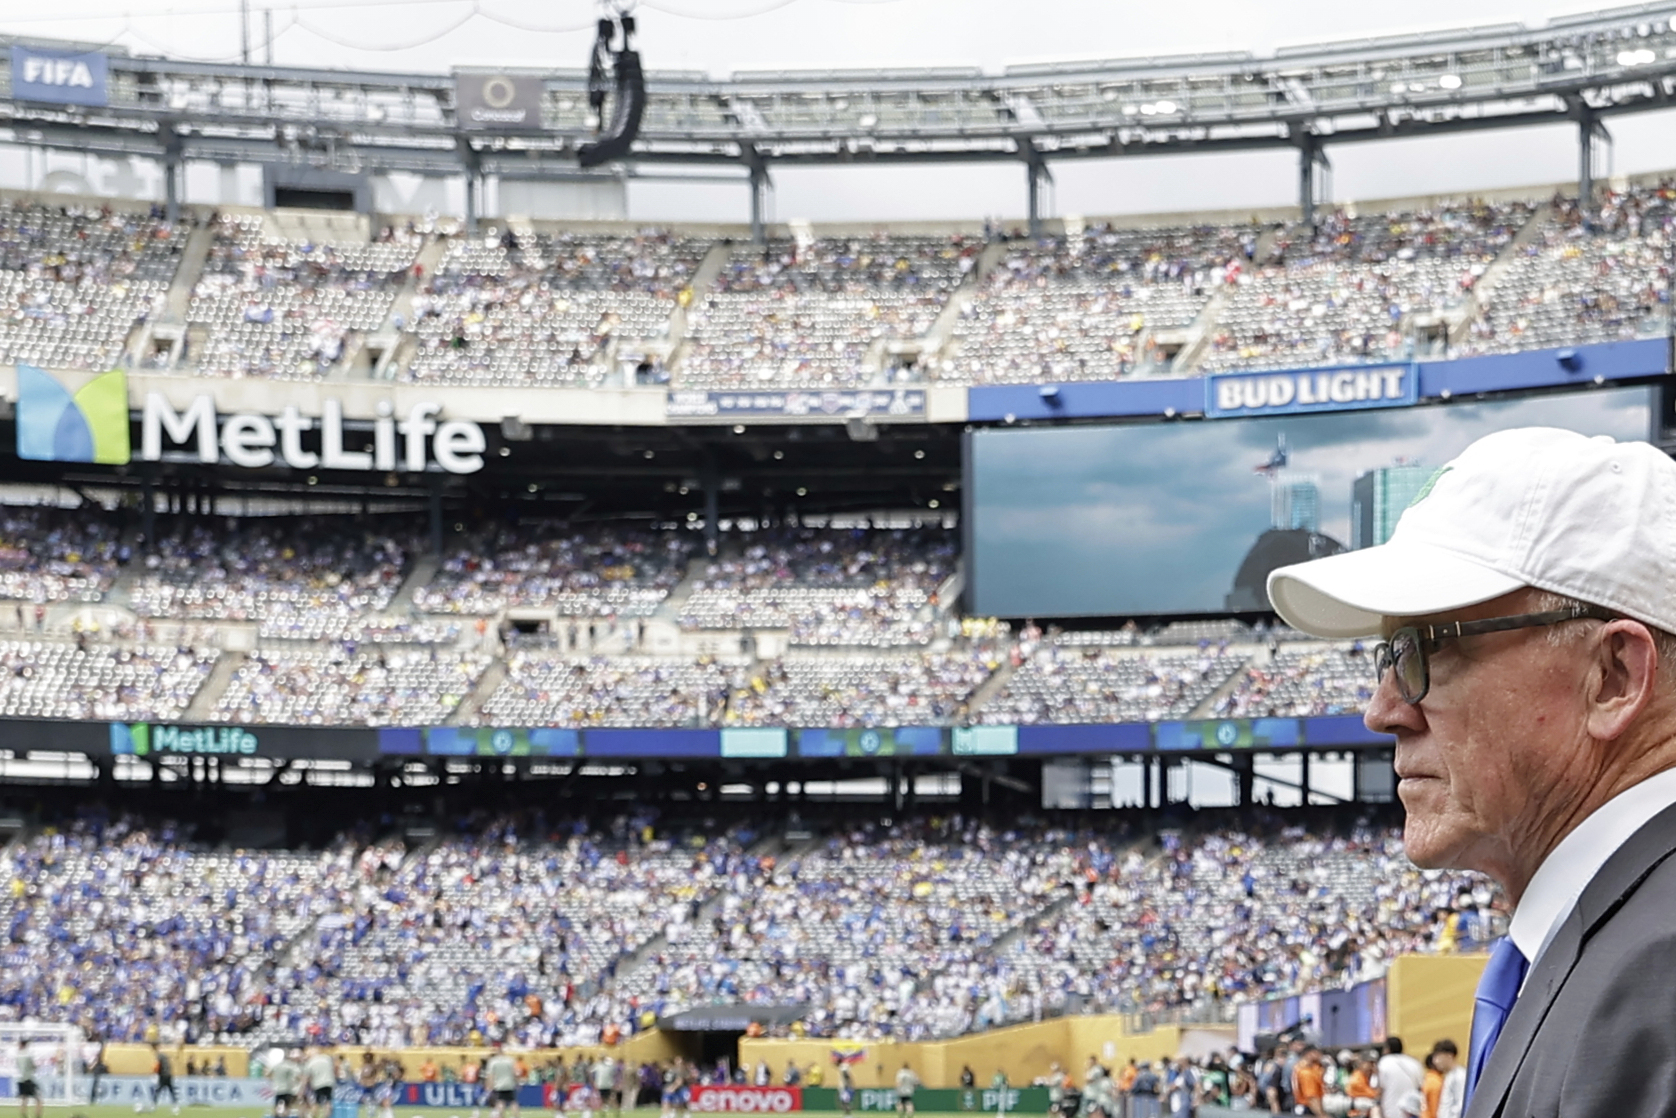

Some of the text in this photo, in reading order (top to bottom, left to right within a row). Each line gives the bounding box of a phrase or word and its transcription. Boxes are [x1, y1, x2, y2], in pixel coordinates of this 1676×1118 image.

[23, 56, 94, 89] FIFA
[1218, 368, 1406, 411] BUD LIGHT
[141, 391, 487, 475] MetLife
[152, 725, 259, 755] MetLife
[424, 1082, 475, 1107] ULT
[860, 1089, 899, 1112] PIF
